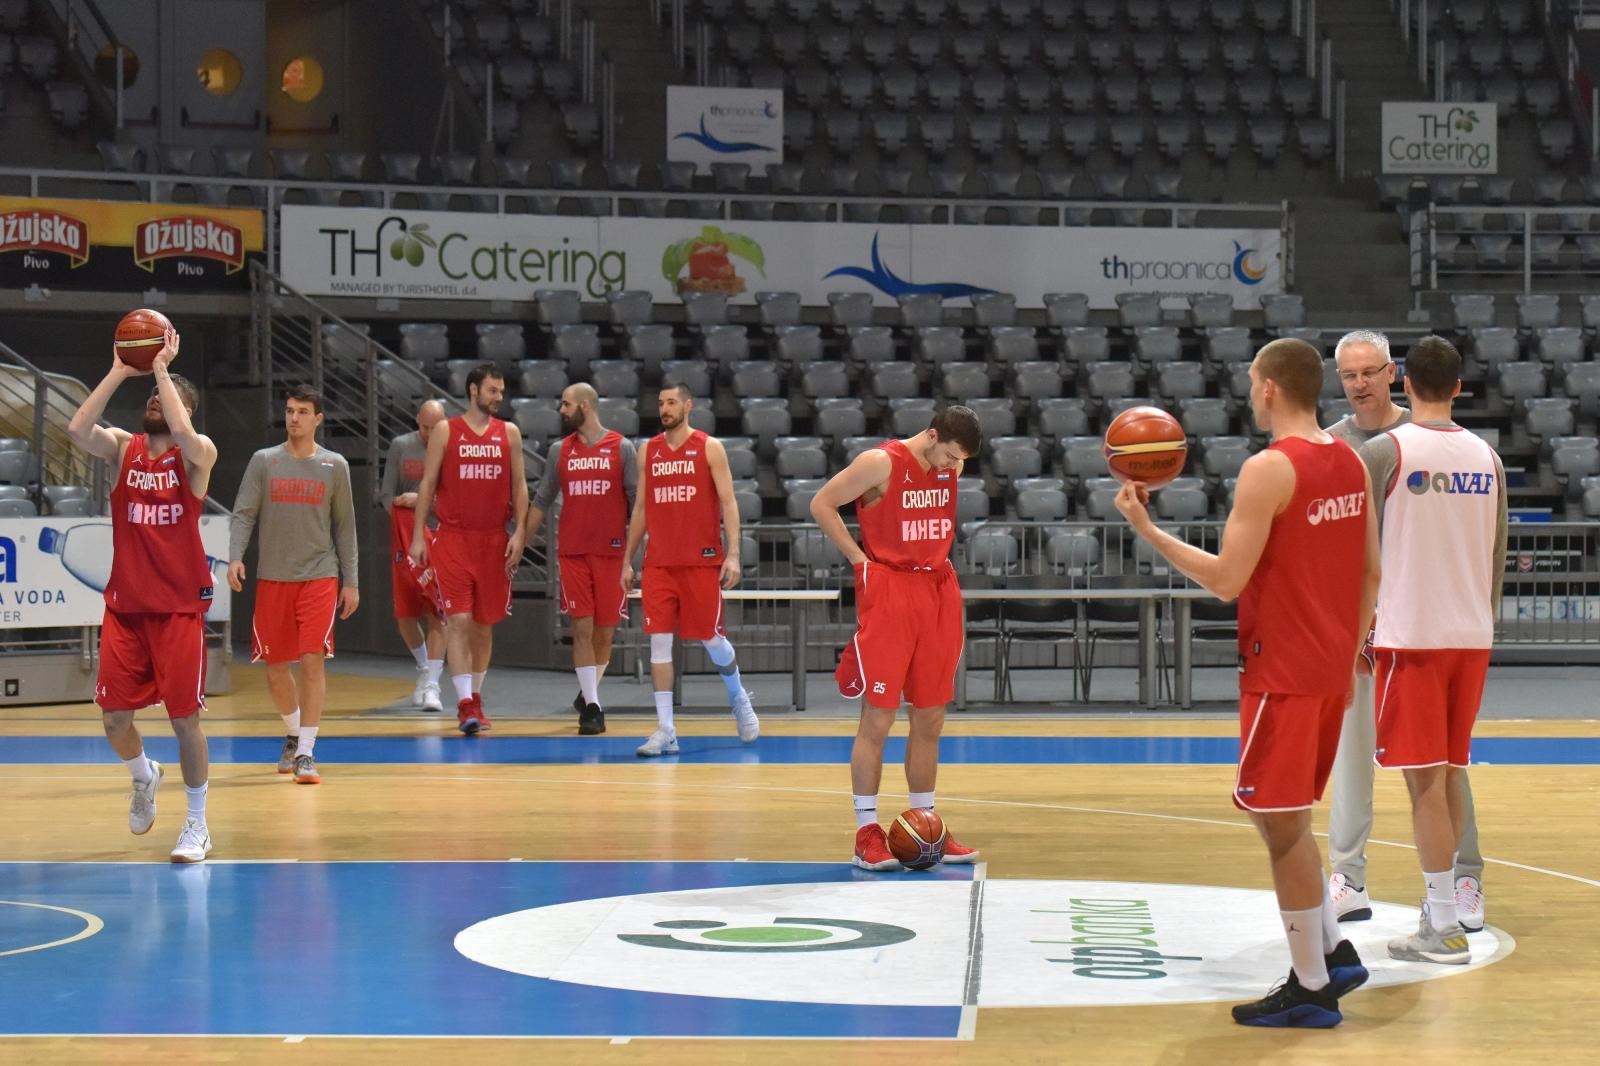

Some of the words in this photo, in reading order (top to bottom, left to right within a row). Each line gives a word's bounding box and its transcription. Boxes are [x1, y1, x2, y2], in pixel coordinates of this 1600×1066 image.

[1389, 136, 1489, 168] Catering
[145, 214, 235, 256] Ožujsko
[24, 254, 50, 269] Pivo
[178, 262, 204, 276] Pivo
[438, 233, 626, 298] Catering
[1100, 255, 1231, 286] thpraonica
[330, 282, 381, 293] MANAGED
[383, 283, 394, 293] BY
[459, 445, 502, 458] CROATIA
[568, 457, 611, 471] CROATIA
[652, 460, 695, 477] CROATIA
[127, 469, 180, 490] CROATIA
[902, 488, 949, 509] CROATIA
[15, 590, 65, 605] VODA
[0, 611, 21, 622] ER
[101, 685, 106, 697] 4
[873, 681, 886, 694] 25
